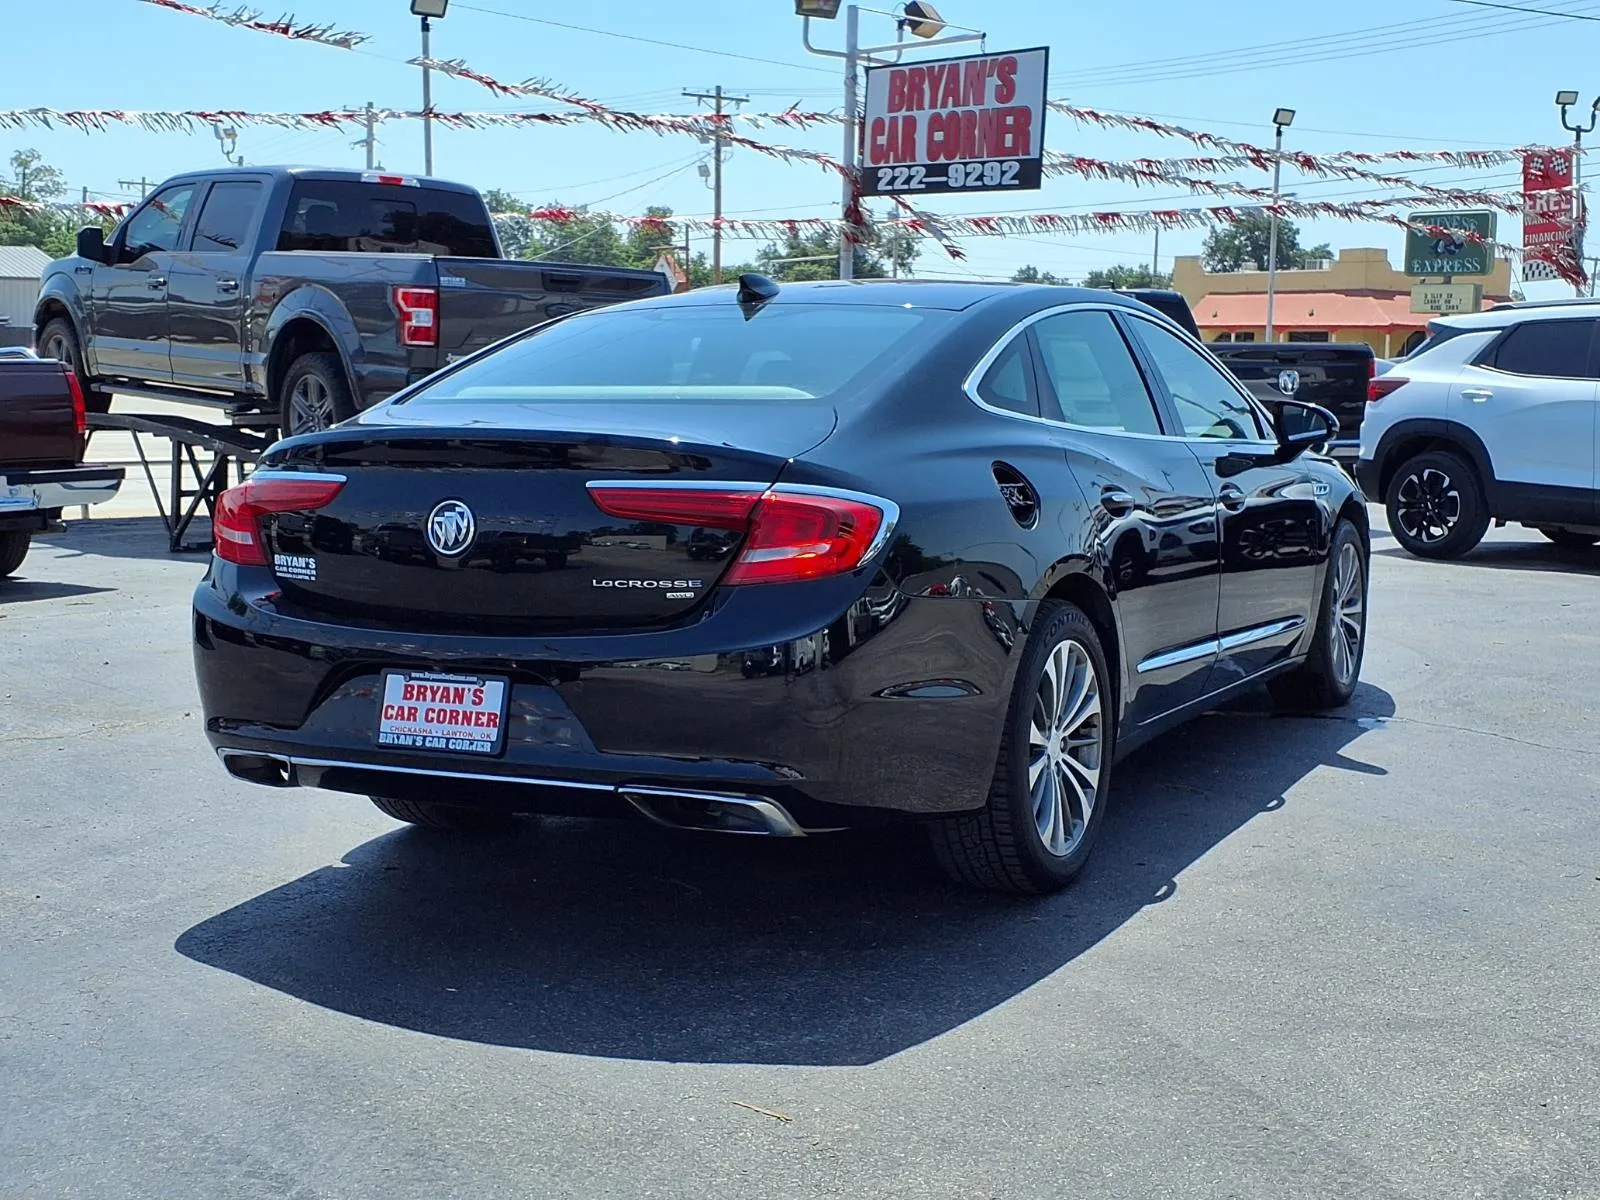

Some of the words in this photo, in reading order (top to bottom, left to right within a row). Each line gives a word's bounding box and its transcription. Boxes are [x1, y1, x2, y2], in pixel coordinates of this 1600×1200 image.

[887, 56, 1019, 114] BRYAN'S
[870, 115, 917, 165] CAR
[926, 105, 1033, 163] CORNER
[877, 161, 1020, 191] 222-9292
[1524, 230, 1571, 245] FINANCING
[1412, 257, 1481, 273] EXPRESS
[274, 554, 316, 569] BRYAN'S
[402, 683, 485, 707] BRYAN'S
[383, 704, 419, 723] CAR
[424, 707, 499, 729] CORNER
[425, 737, 446, 749] CAR
[480, 732, 492, 740] OK
